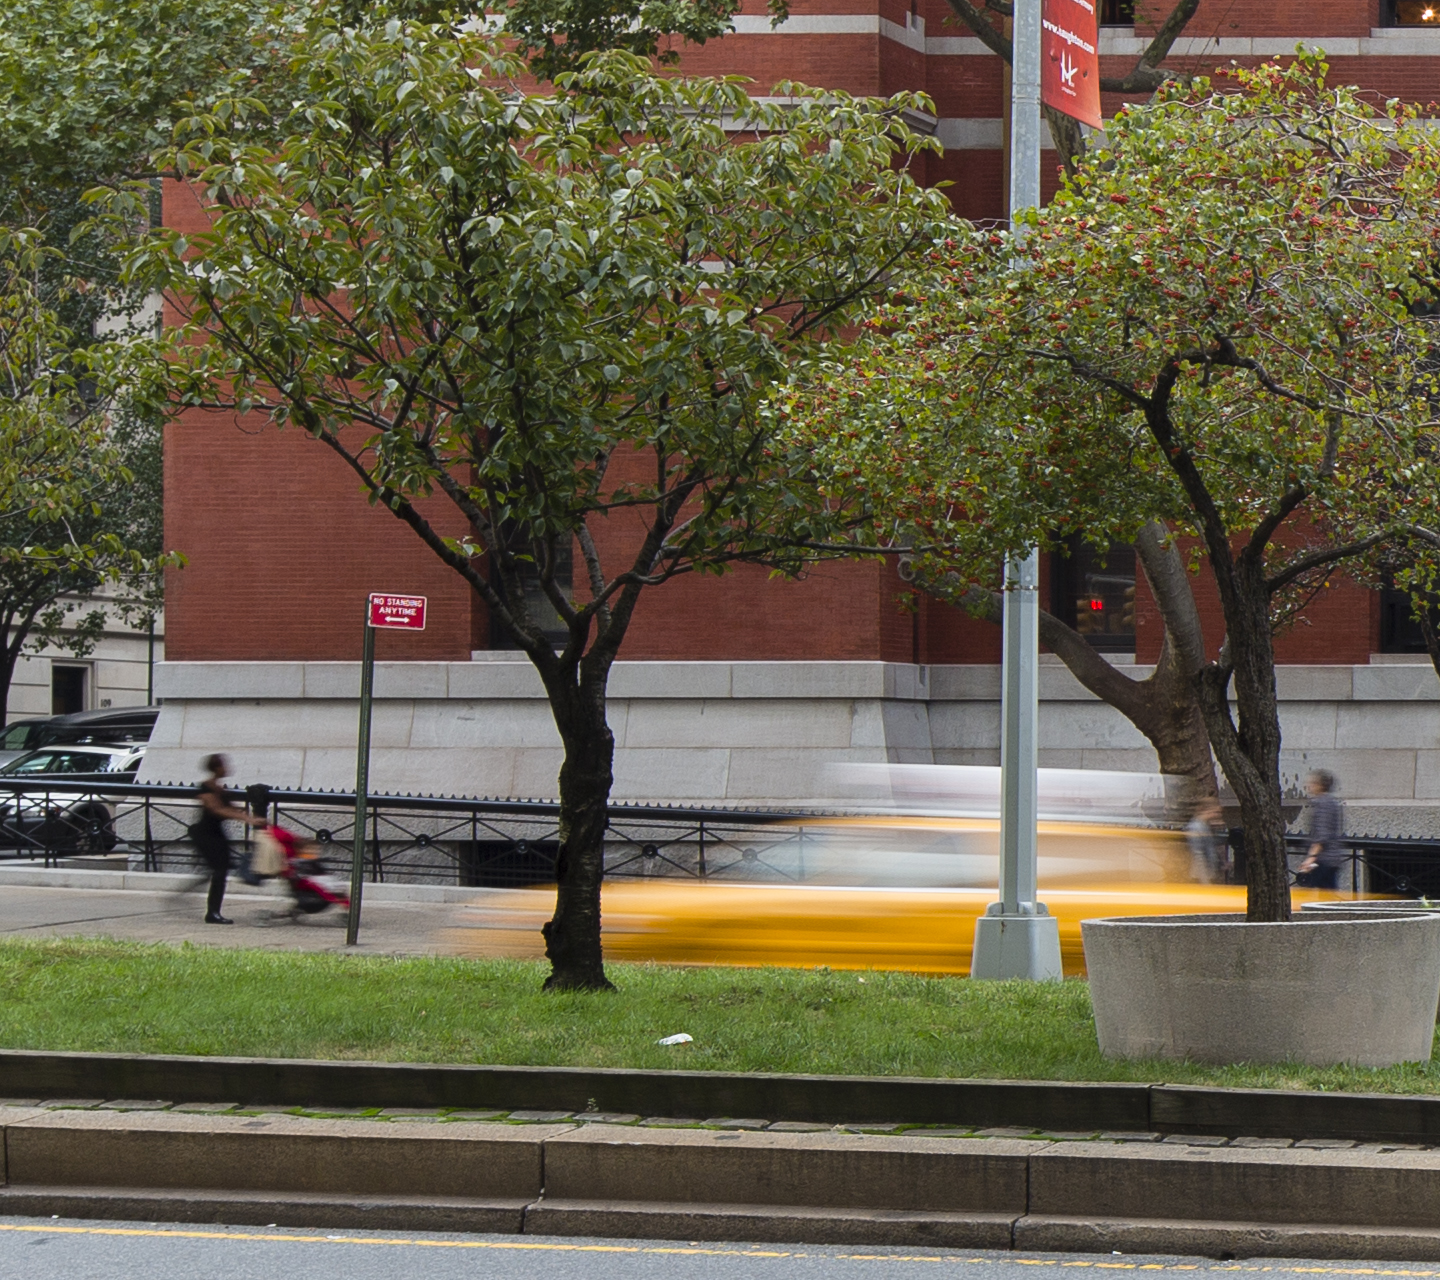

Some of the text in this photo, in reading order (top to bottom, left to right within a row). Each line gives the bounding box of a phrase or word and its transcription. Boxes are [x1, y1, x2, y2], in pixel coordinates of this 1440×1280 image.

[373, 597, 422, 608] NO STANDING
[379, 606, 417, 616] ANYTIME
